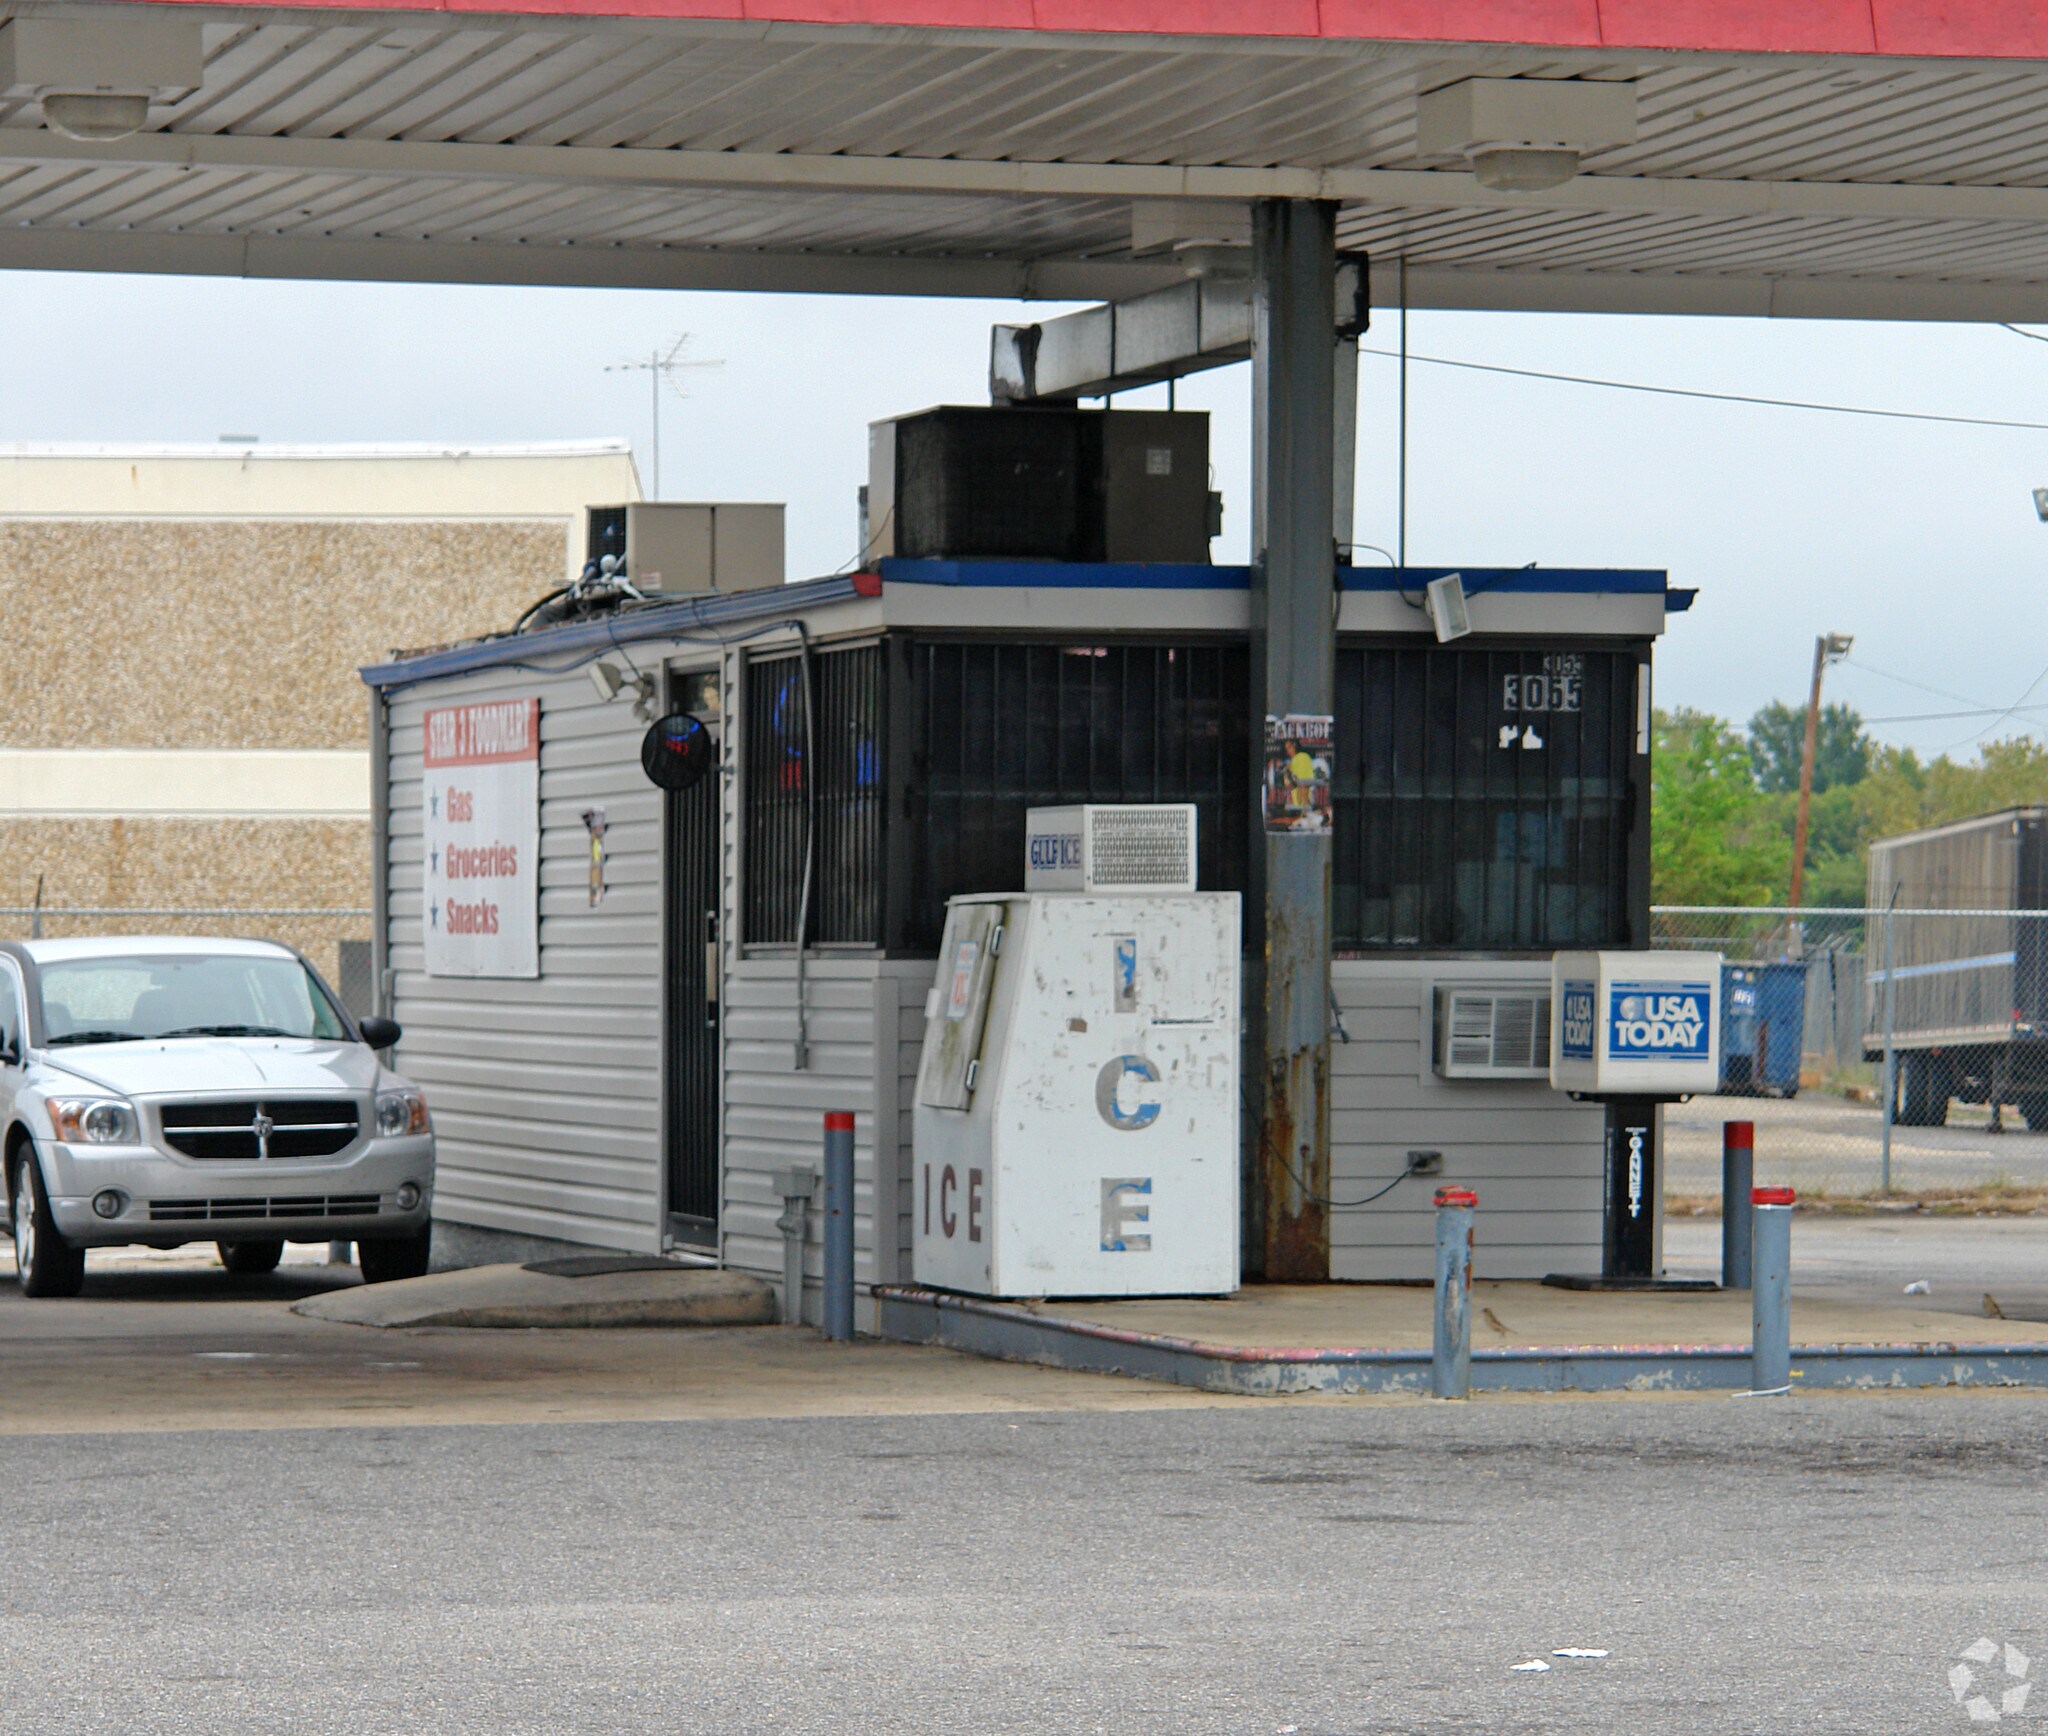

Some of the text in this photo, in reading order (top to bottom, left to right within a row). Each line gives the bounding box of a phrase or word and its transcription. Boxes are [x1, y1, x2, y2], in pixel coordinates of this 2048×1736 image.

[428, 699, 529, 759] STAR 3 FOODMART
[447, 785, 473, 822] Gas
[446, 840, 517, 879] Groceries
[1060, 837, 1081, 865] ICE
[446, 897, 498, 934] Snacks
[1573, 996, 1592, 1020] USA
[1645, 996, 1701, 1022] USA
[1565, 1021, 1592, 1046] TODAY
[1615, 1021, 1703, 1048] TODAY
[924, 1163, 982, 1243] ICE
